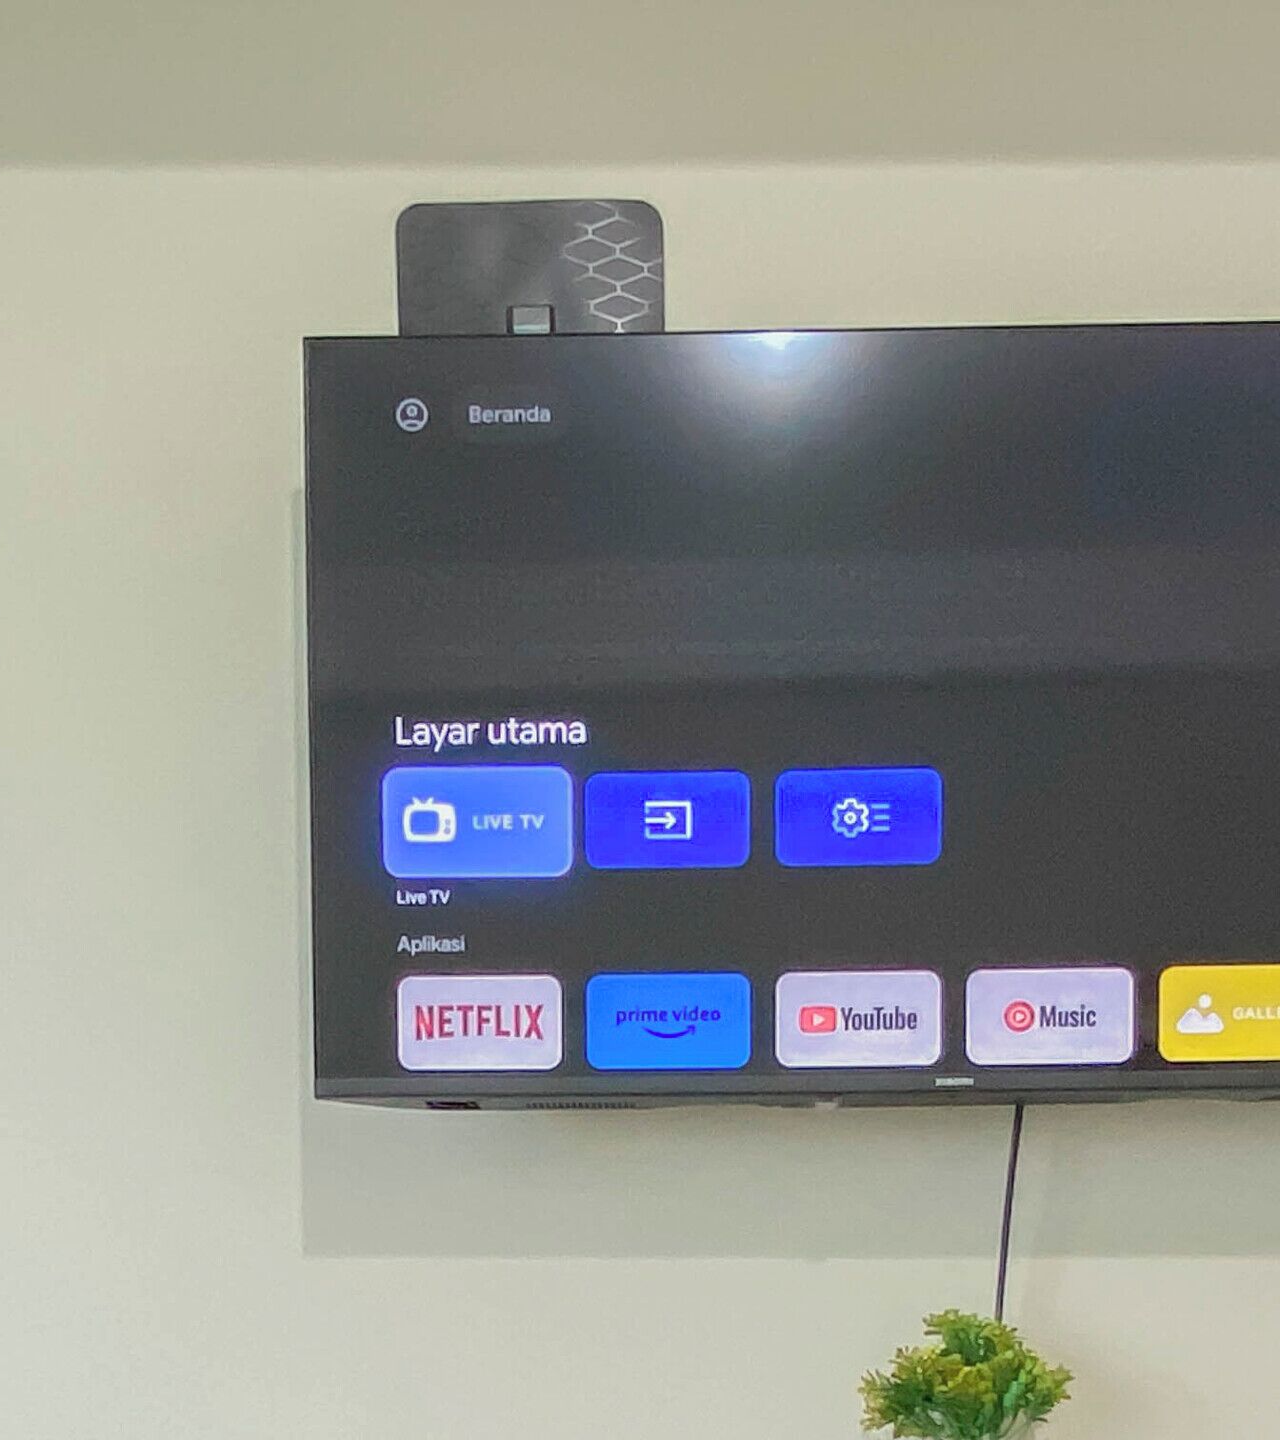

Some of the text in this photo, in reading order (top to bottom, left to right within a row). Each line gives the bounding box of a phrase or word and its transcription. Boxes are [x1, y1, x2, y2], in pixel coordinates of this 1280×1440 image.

[468, 404, 552, 424] Beranda
[395, 716, 588, 752] Layar utama
[472, 814, 545, 830] LIVE TV
[396, 889, 451, 905] Live TV
[396, 935, 466, 956] Aplikasi
[415, 1004, 544, 1041] NETFLIX
[616, 1004, 722, 1026] prime video
[841, 1006, 918, 1031] YouTube
[1039, 1004, 1097, 1028] Music
